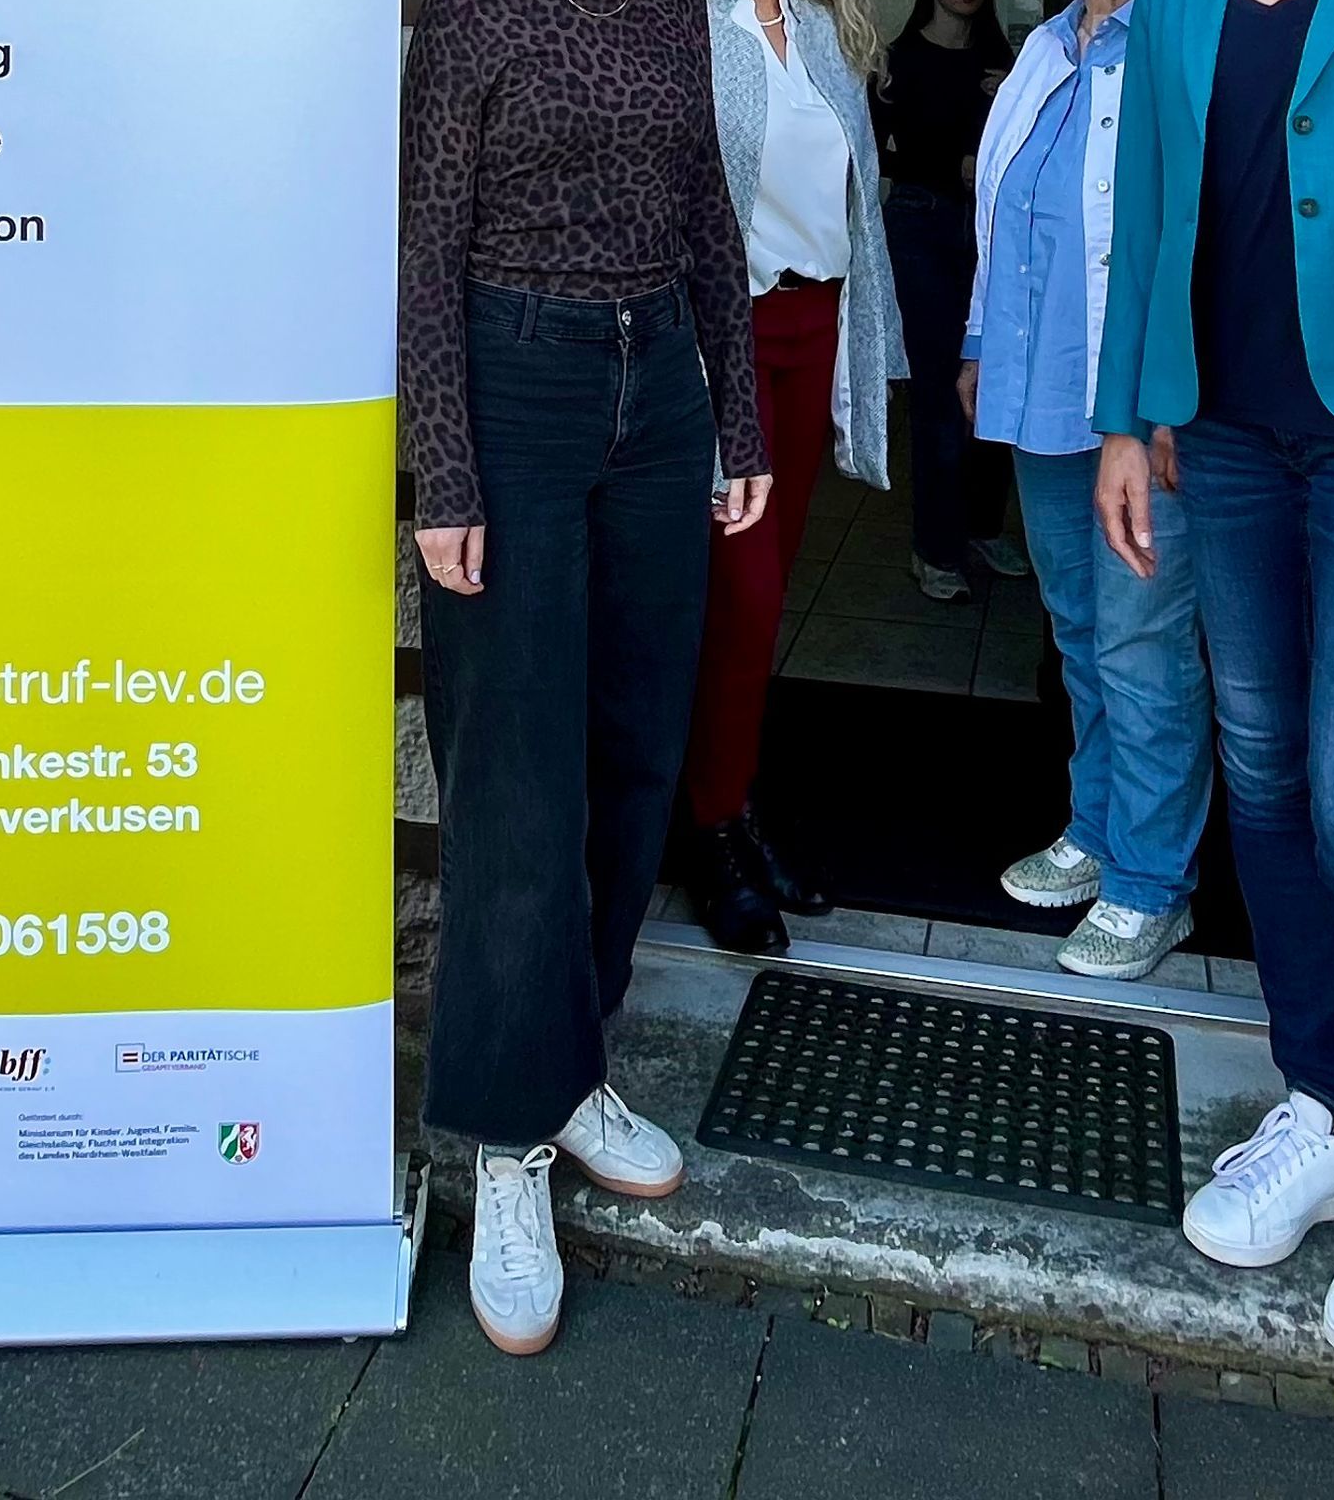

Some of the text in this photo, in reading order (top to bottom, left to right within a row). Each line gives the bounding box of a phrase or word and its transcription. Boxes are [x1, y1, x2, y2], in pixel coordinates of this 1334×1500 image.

[145, 743, 199, 779] 53
[141, 1048, 260, 1063] DER PARITÄTISCHE
[118, 1137, 137, 1148] und
[18, 1152, 35, 1161] des
